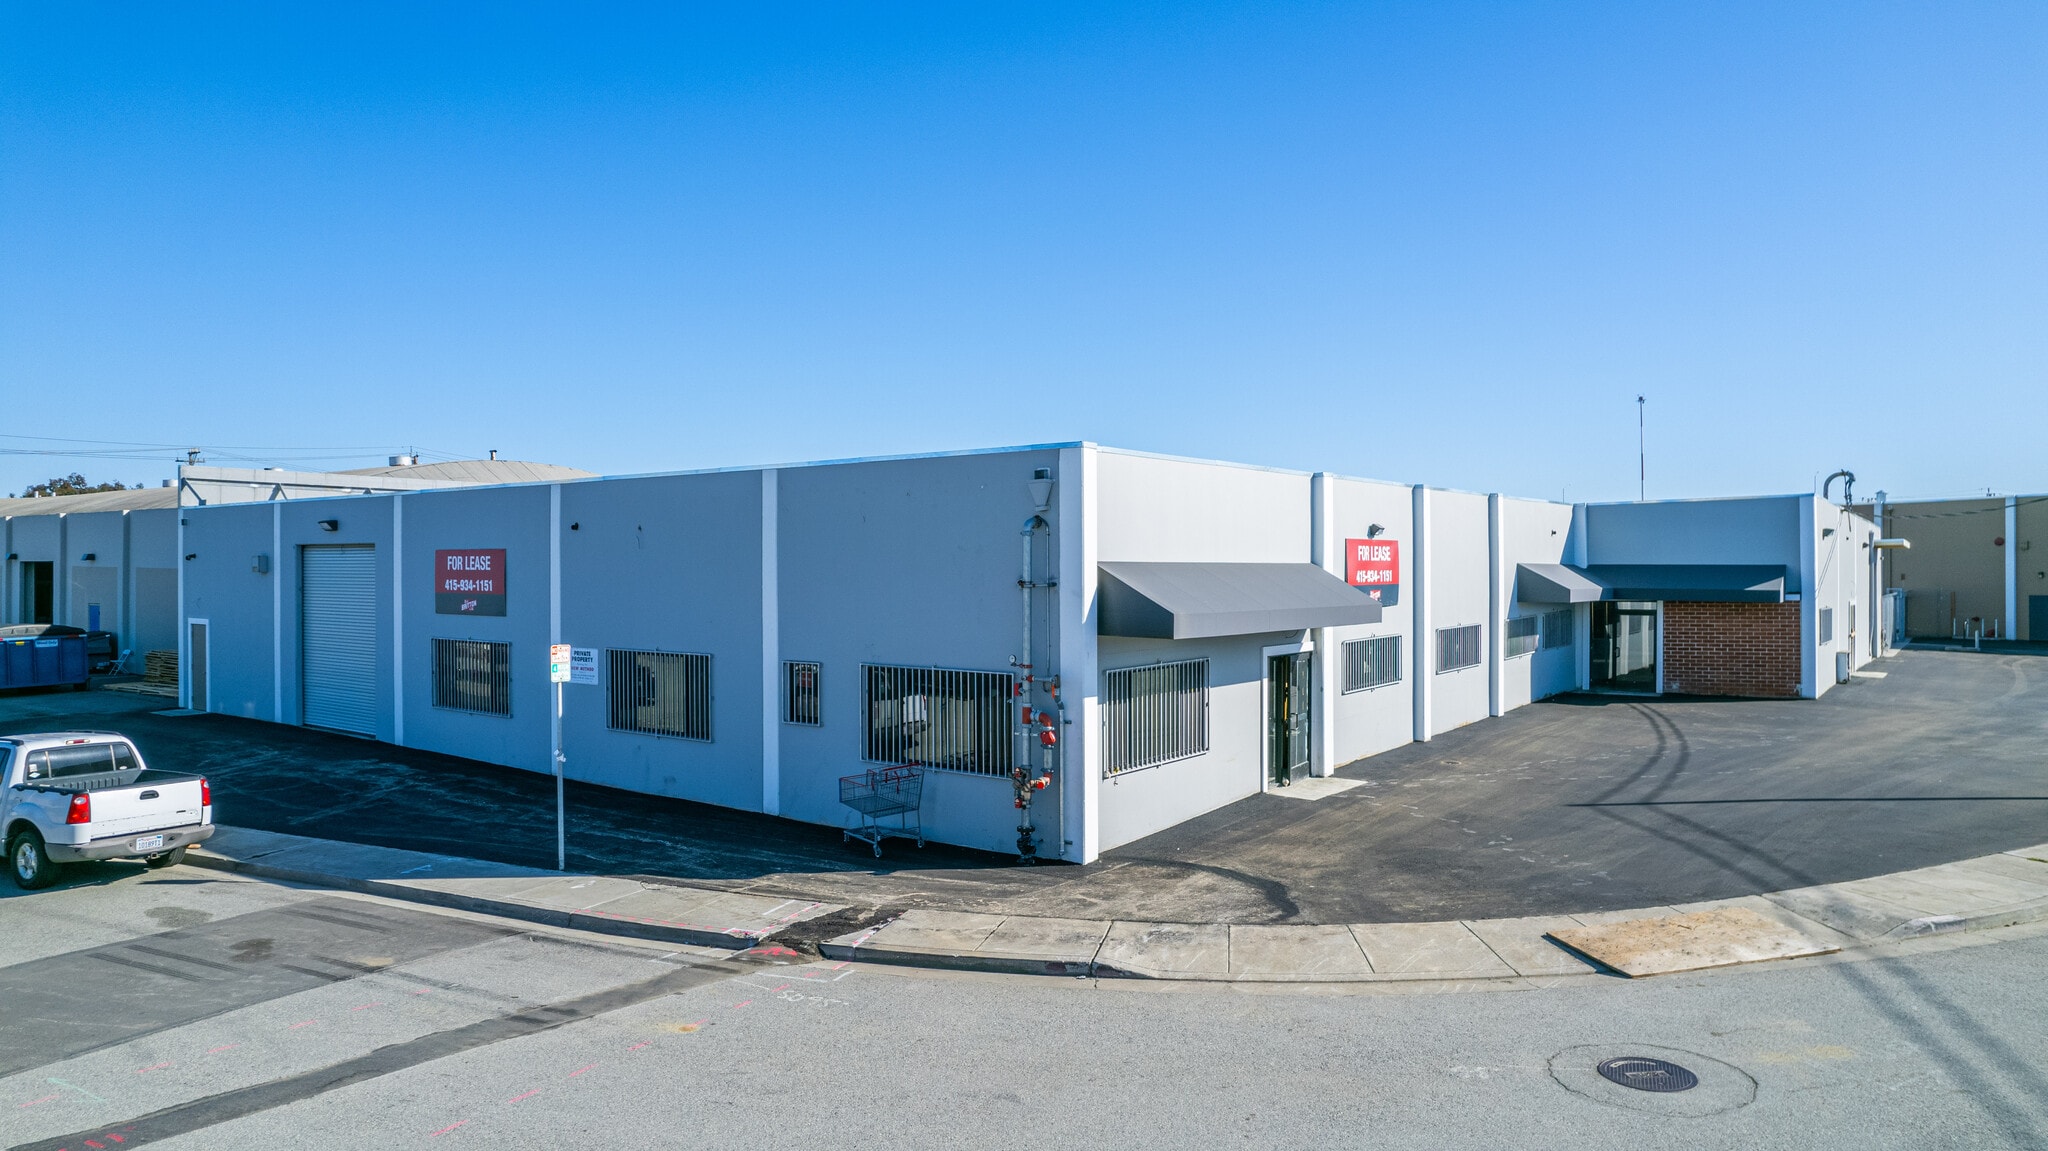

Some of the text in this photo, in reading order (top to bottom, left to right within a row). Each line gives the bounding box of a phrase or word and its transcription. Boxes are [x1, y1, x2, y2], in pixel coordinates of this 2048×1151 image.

[1357, 545, 1391, 562] FOR LEASE
[447, 555, 491, 571] FOR LEASE
[1356, 569, 1393, 583] 415-934-1151
[444, 579, 493, 592] 415-934-1151
